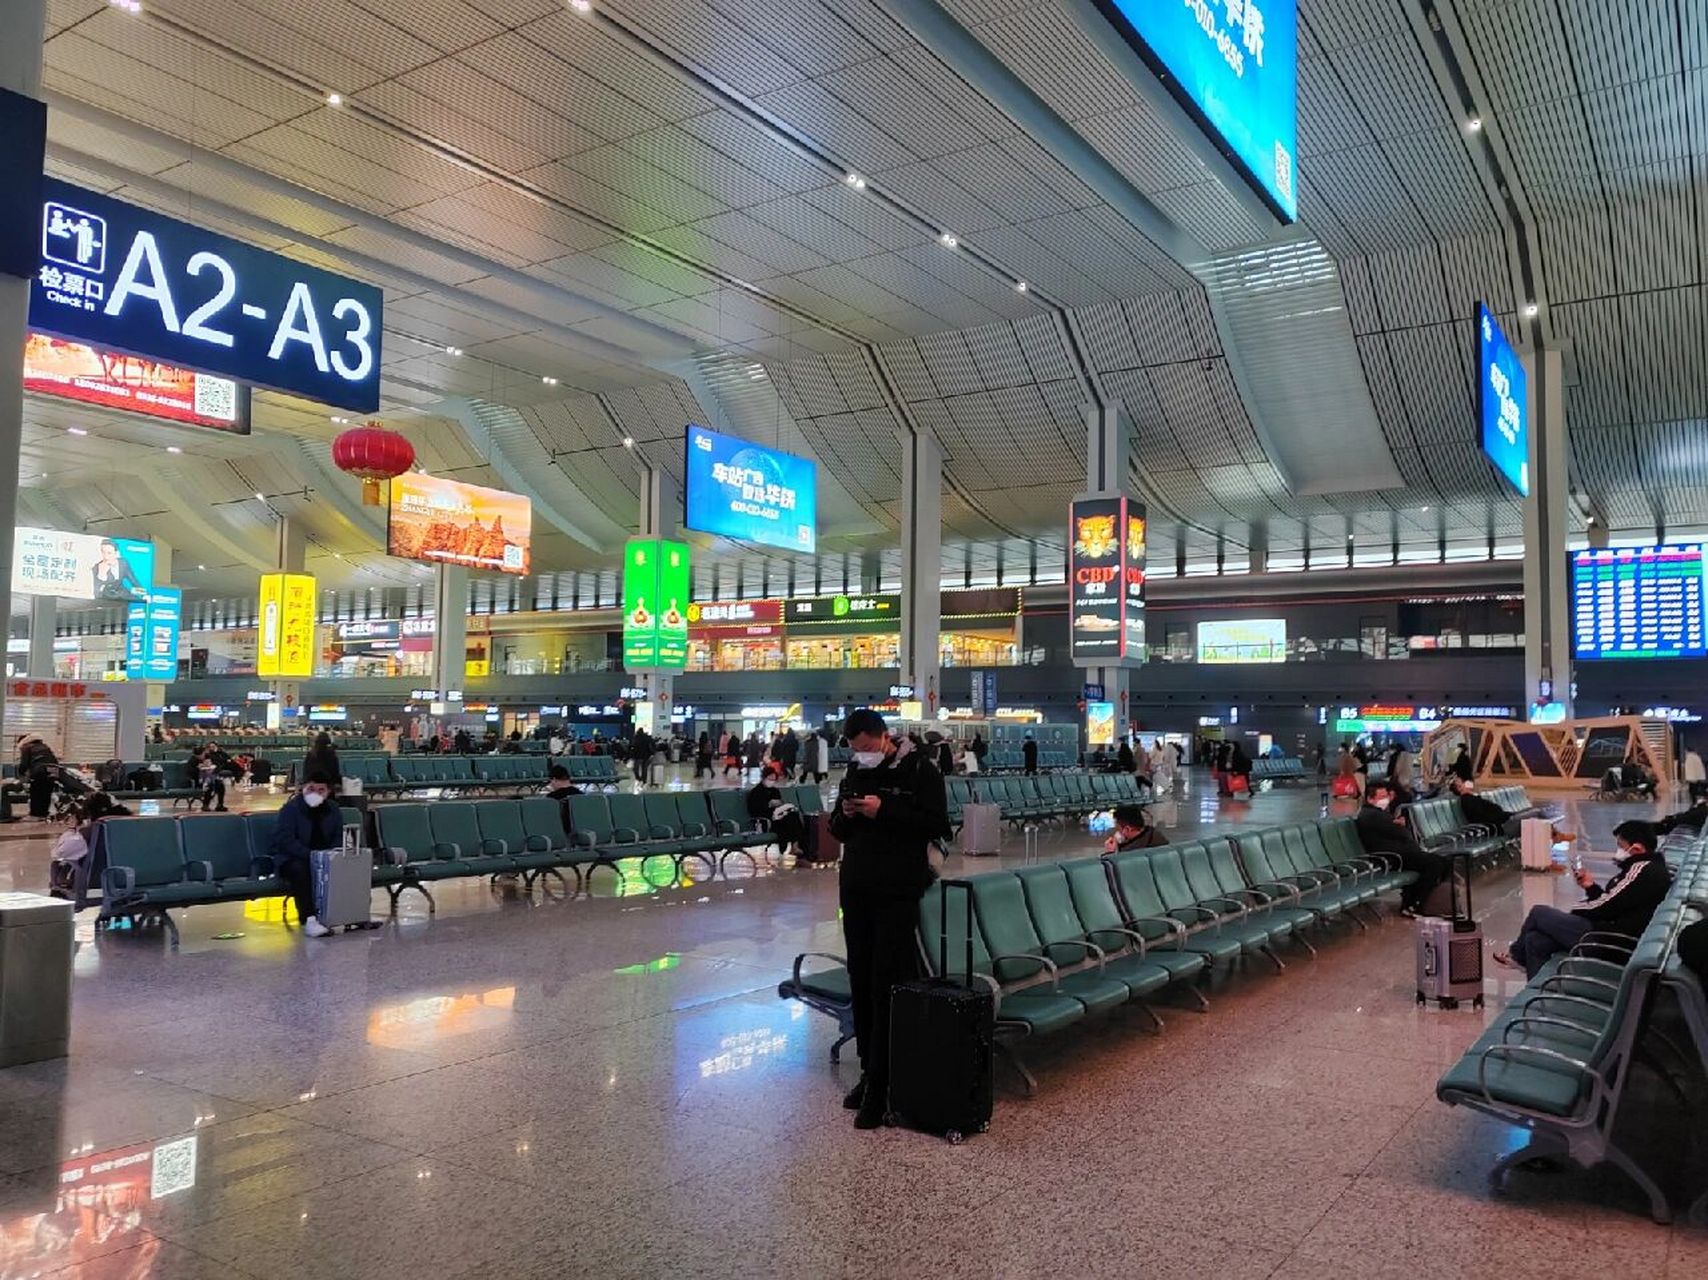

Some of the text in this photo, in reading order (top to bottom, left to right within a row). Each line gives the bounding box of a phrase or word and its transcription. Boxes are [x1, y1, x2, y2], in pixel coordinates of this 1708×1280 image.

[39, 265, 104, 301] 检票口
[46, 290, 95, 312] Check in
[104, 230, 373, 382] A2-A3
[1076, 567, 1115, 584] CBD
